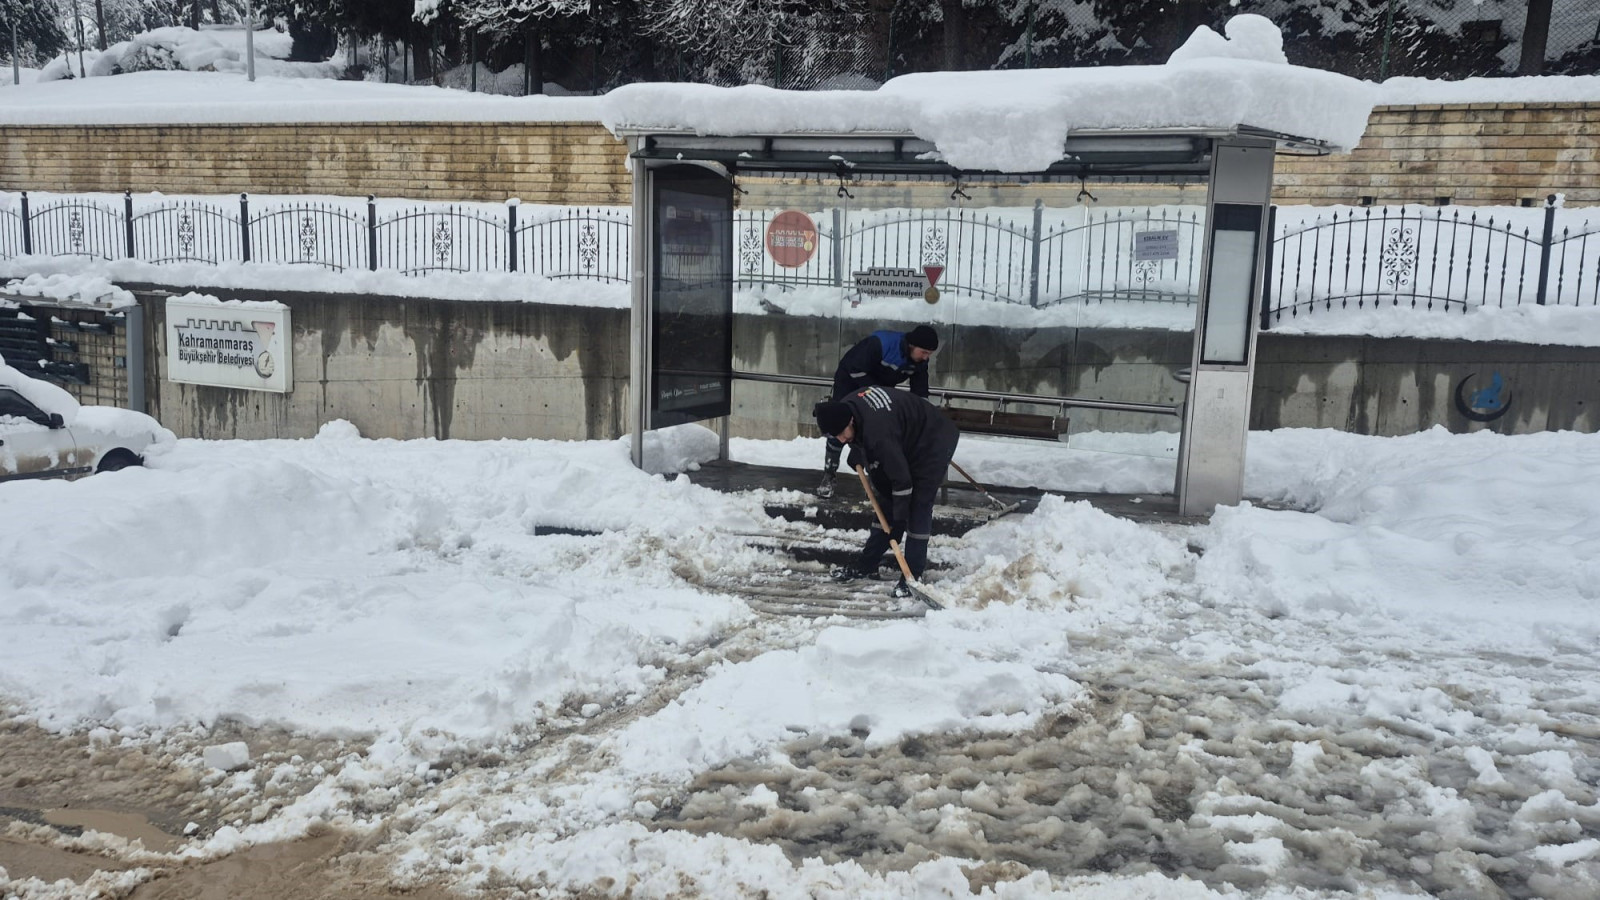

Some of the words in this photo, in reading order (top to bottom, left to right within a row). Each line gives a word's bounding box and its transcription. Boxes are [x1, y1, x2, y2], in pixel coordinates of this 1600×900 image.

[856, 278, 923, 290] Kahramanmaraş
[890, 288, 923, 298] Belediyesi
[178, 332, 253, 353] Kahramanmaraş
[179, 349, 217, 364] Büyükşehir
[217, 350, 255, 369] Belediyesi
